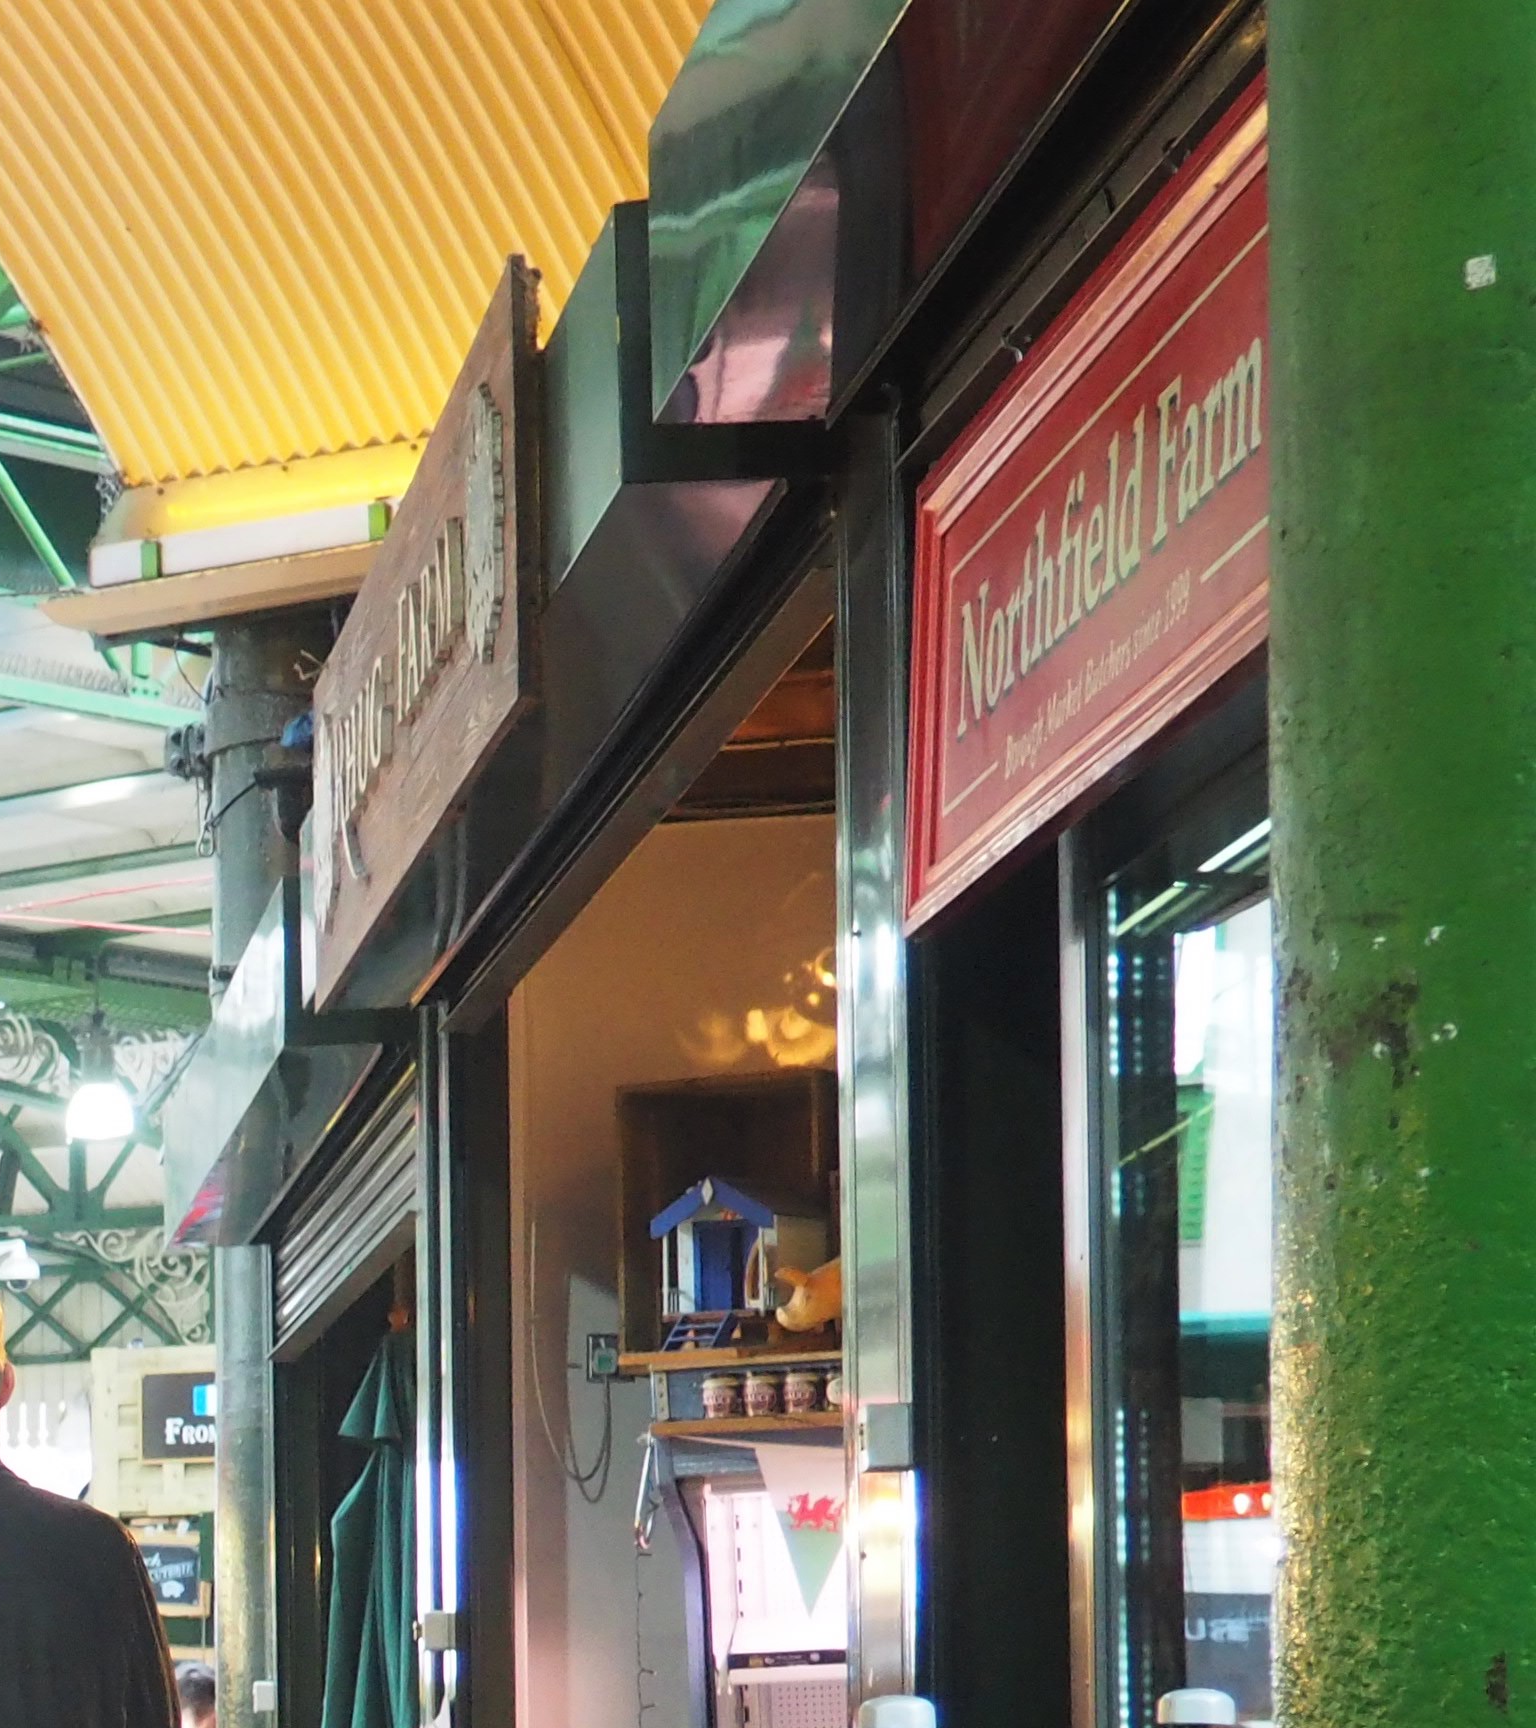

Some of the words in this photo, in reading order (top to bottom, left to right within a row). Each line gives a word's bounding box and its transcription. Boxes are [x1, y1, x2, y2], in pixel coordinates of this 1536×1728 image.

[397, 517, 455, 724] FARM
[957, 404, 1146, 737] Northfield
[1151, 336, 1263, 547] Farm
